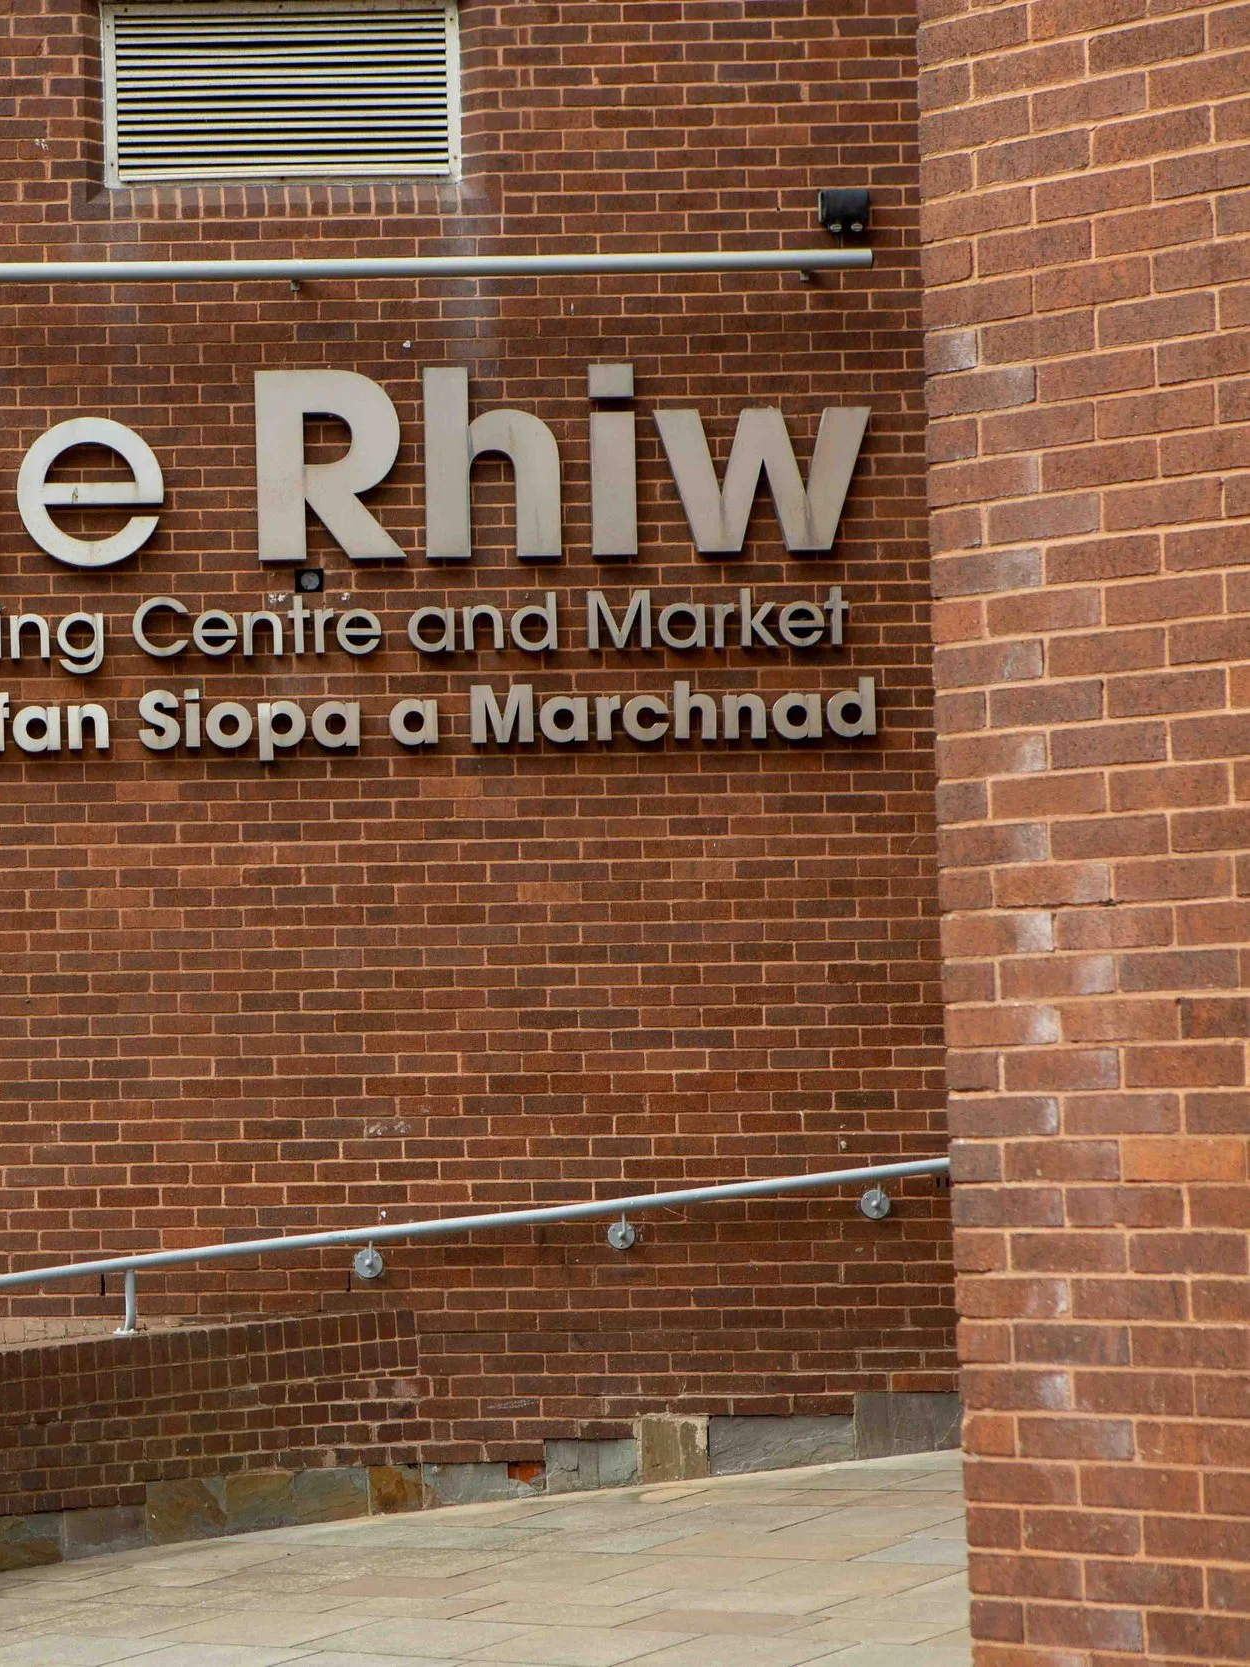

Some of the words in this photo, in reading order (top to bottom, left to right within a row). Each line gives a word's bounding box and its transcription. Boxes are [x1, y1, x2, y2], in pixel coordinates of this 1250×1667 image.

[252, 364, 872, 561] Rhiw
[132, 596, 381, 658] Centre
[408, 591, 558, 654] and
[587, 586, 849, 652] Market
[139, 689, 360, 762] Siopa
[390, 698, 438, 745] a
[471, 676, 877, 745] Marchnad
